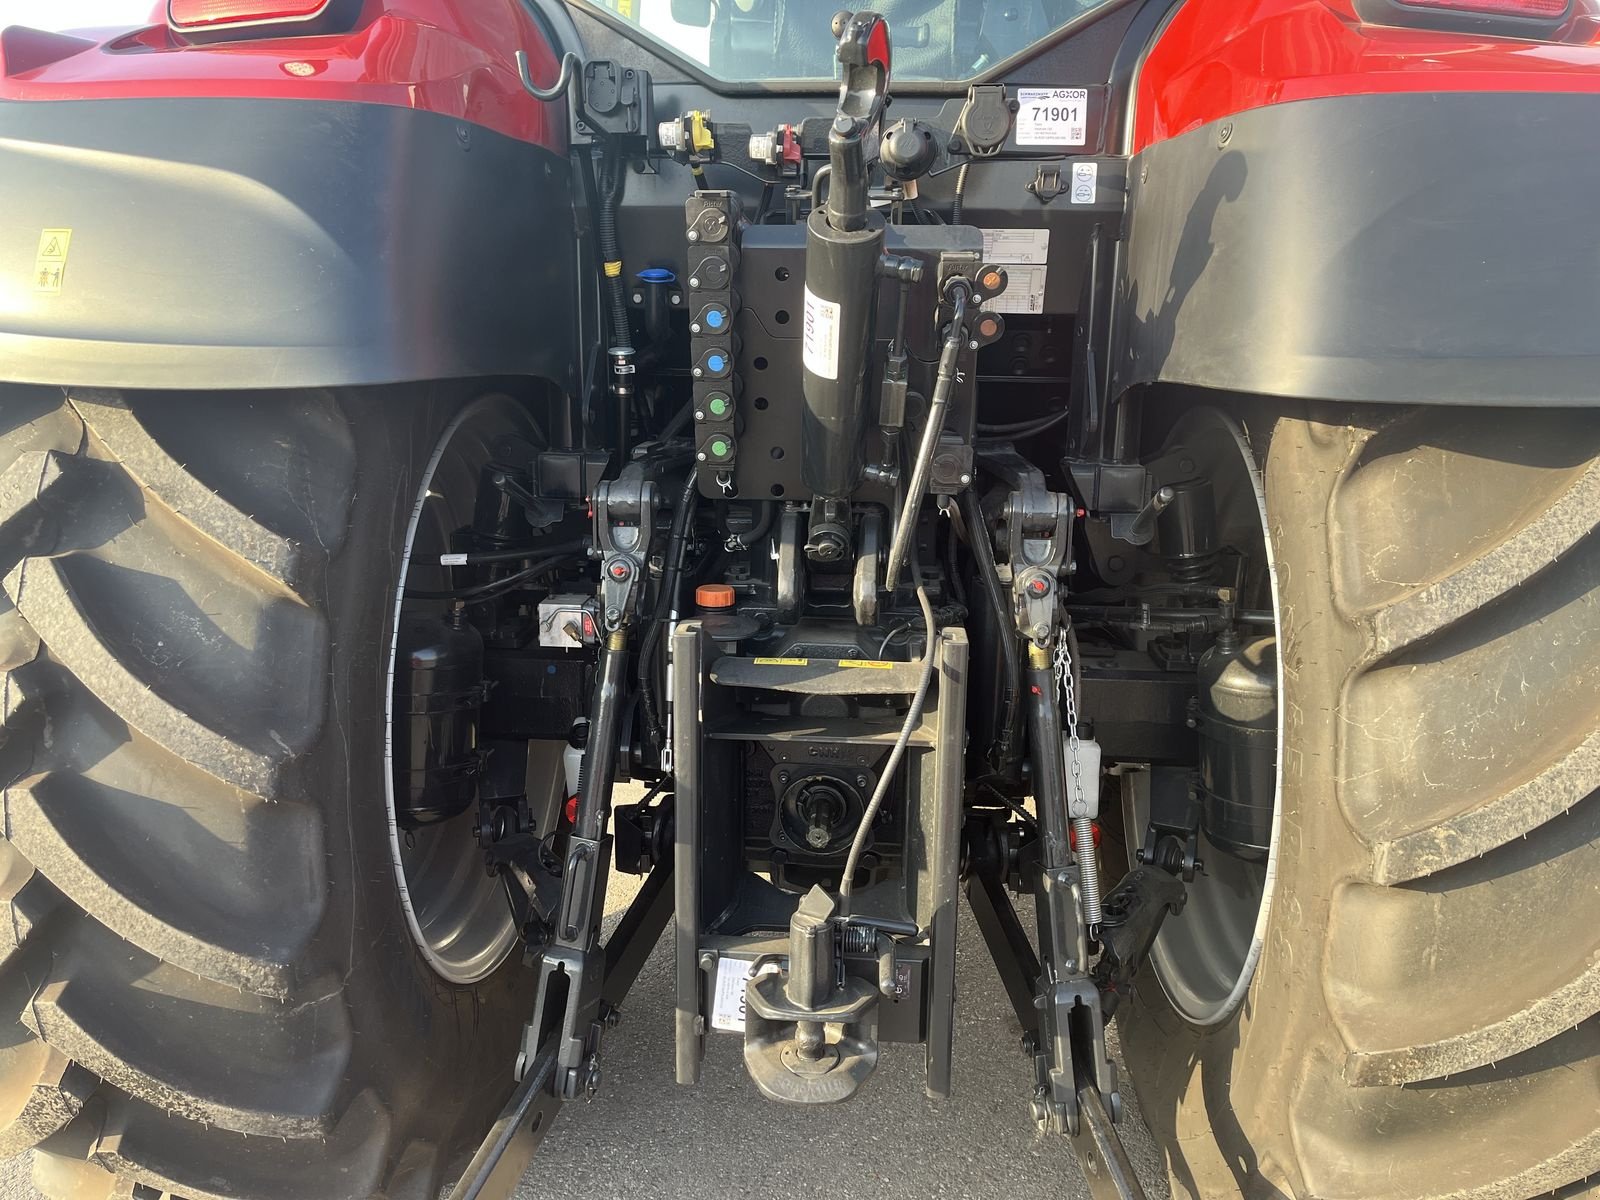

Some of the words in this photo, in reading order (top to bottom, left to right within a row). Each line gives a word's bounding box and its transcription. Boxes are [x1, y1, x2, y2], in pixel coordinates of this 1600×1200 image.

[1052, 90, 1086, 99] AGXOR
[1032, 107, 1077, 121] 71901
[805, 300, 815, 354] 71901
